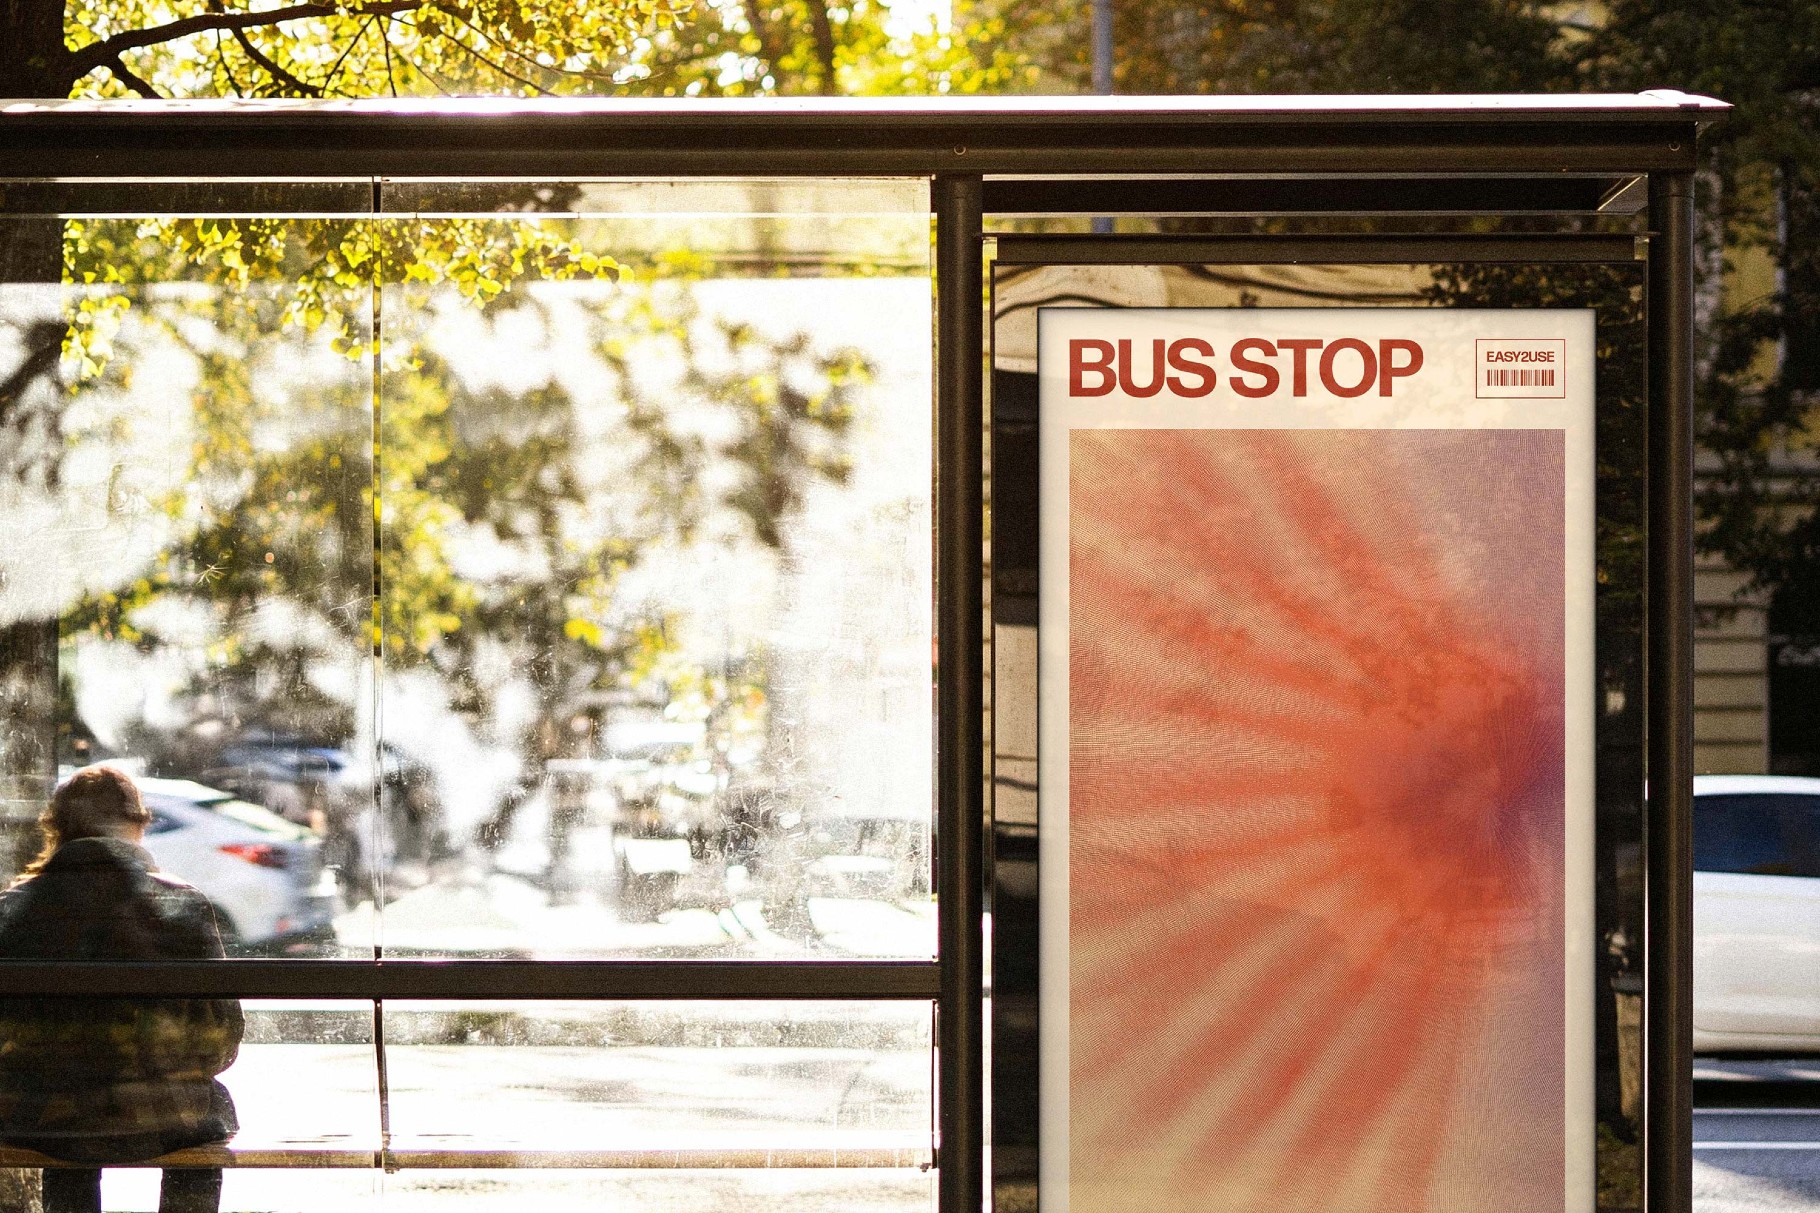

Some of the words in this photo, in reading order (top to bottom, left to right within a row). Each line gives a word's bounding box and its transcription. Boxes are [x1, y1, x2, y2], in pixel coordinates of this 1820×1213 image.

[1069, 338, 1217, 398] BUS
[1229, 338, 1424, 398] STOP
[1486, 351, 1555, 363] EASY2USE
